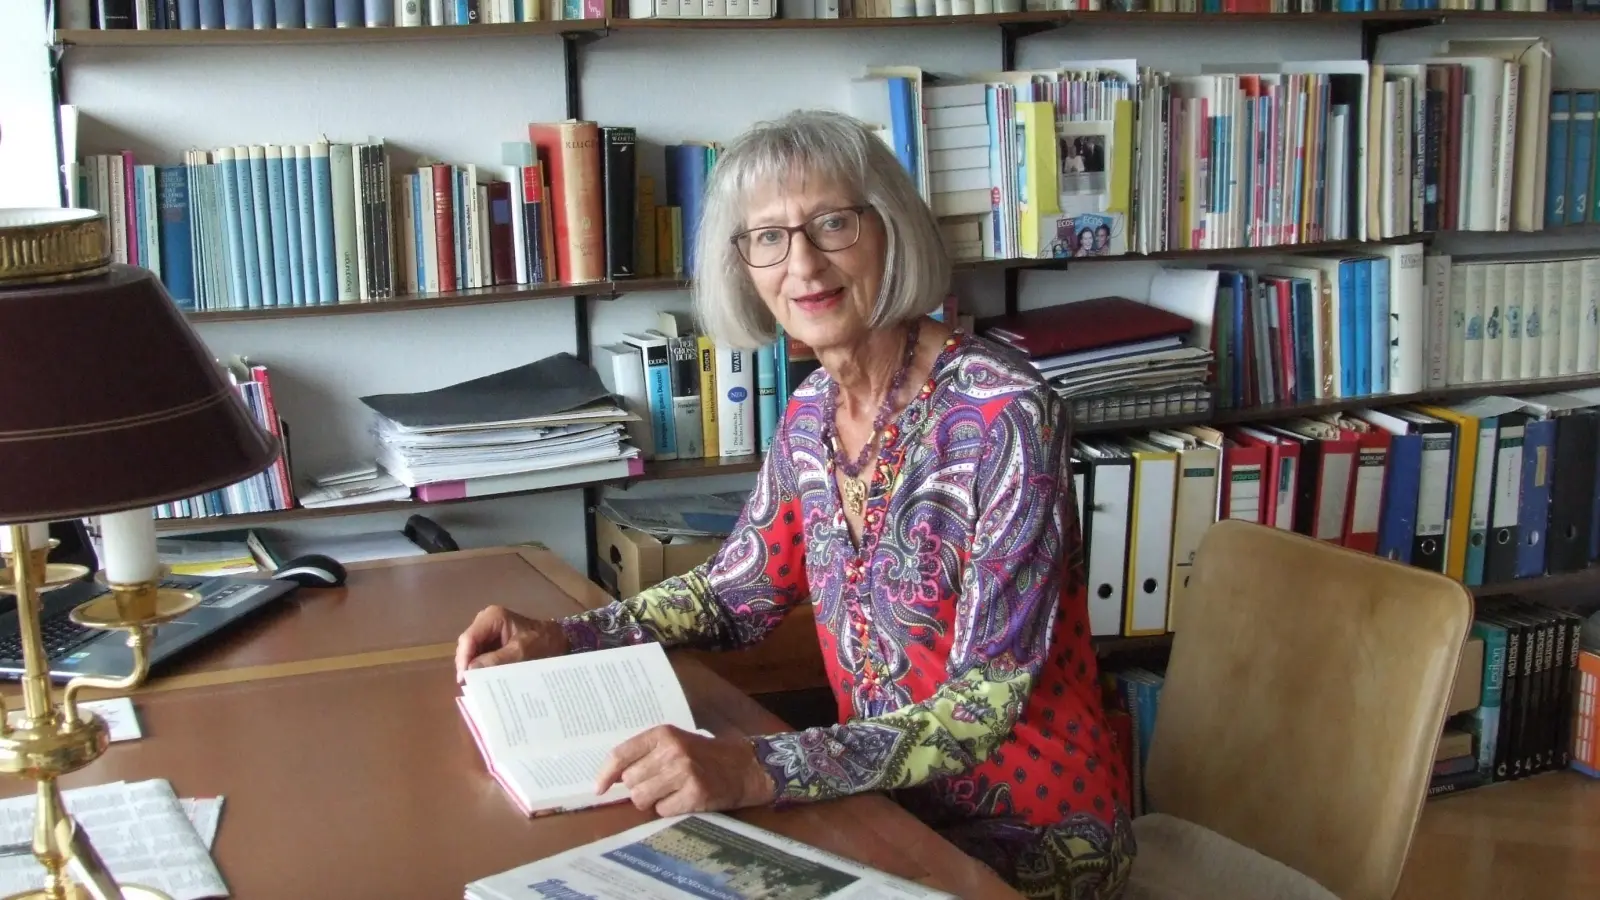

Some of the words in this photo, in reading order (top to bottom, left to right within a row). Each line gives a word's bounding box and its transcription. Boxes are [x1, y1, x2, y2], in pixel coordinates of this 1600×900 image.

[1555, 195, 1564, 214] 2
[1576, 194, 1586, 213] 3
[1057, 219, 1074, 228] ECOS
[1083, 216, 1103, 226] ECOS
